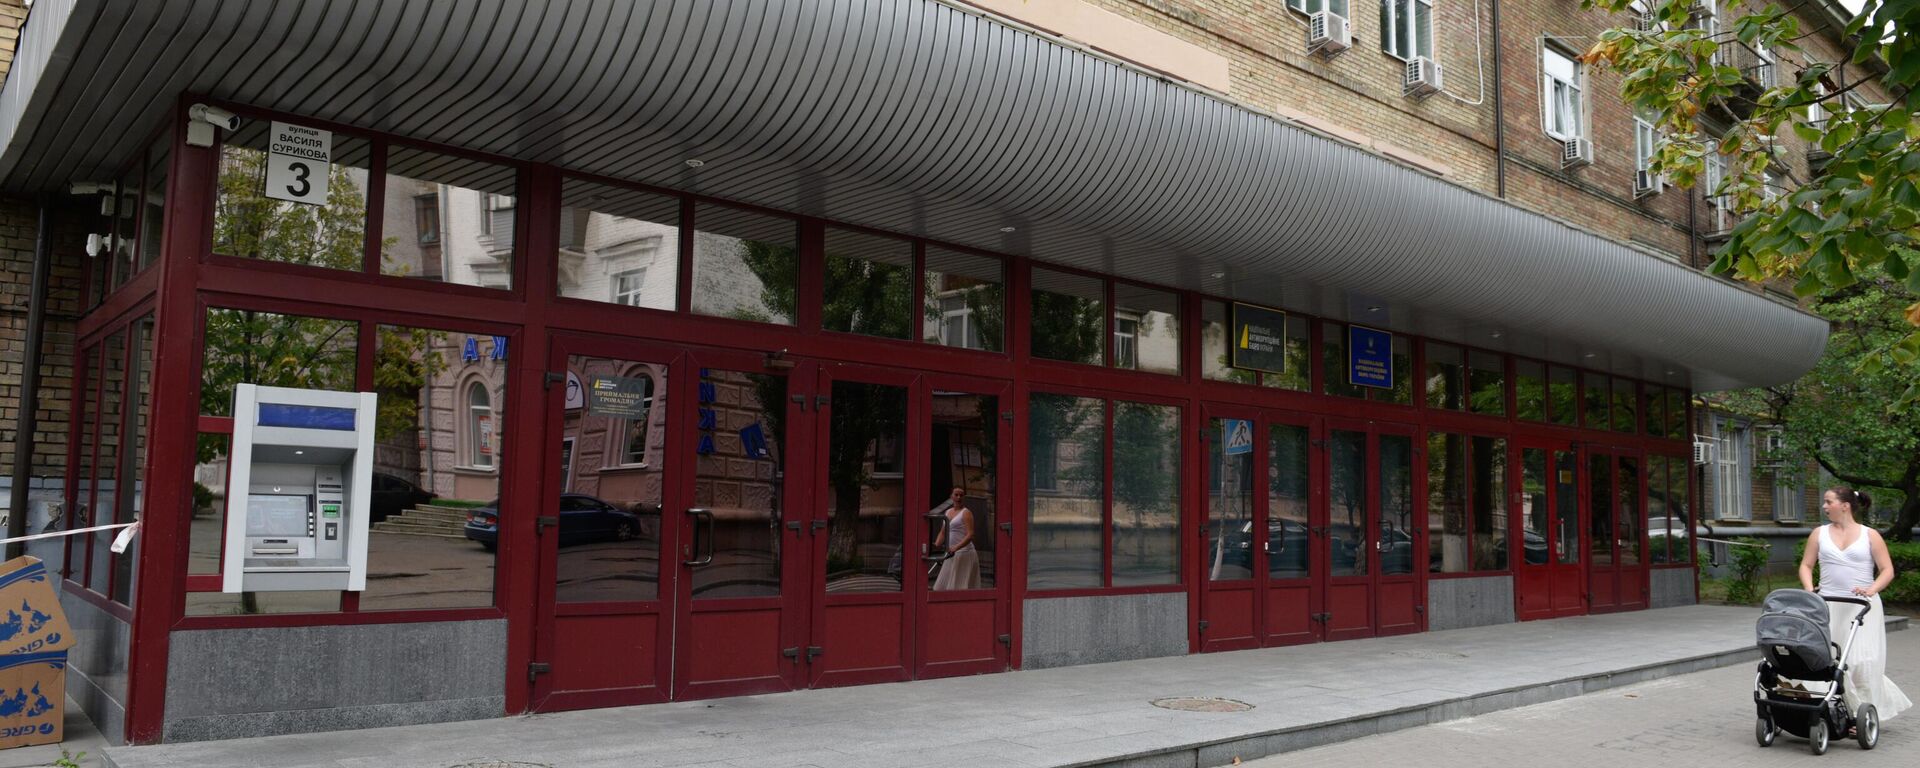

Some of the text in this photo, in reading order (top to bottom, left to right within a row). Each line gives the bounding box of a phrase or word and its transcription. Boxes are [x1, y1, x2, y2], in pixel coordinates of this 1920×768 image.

[288, 126, 319, 136] вулиця
[280, 134, 323, 148] ВАСИЛЯ
[272, 143, 328, 159] СУРИКОВА
[286, 162, 311, 197] 3
[0, 725, 36, 738] GRE
